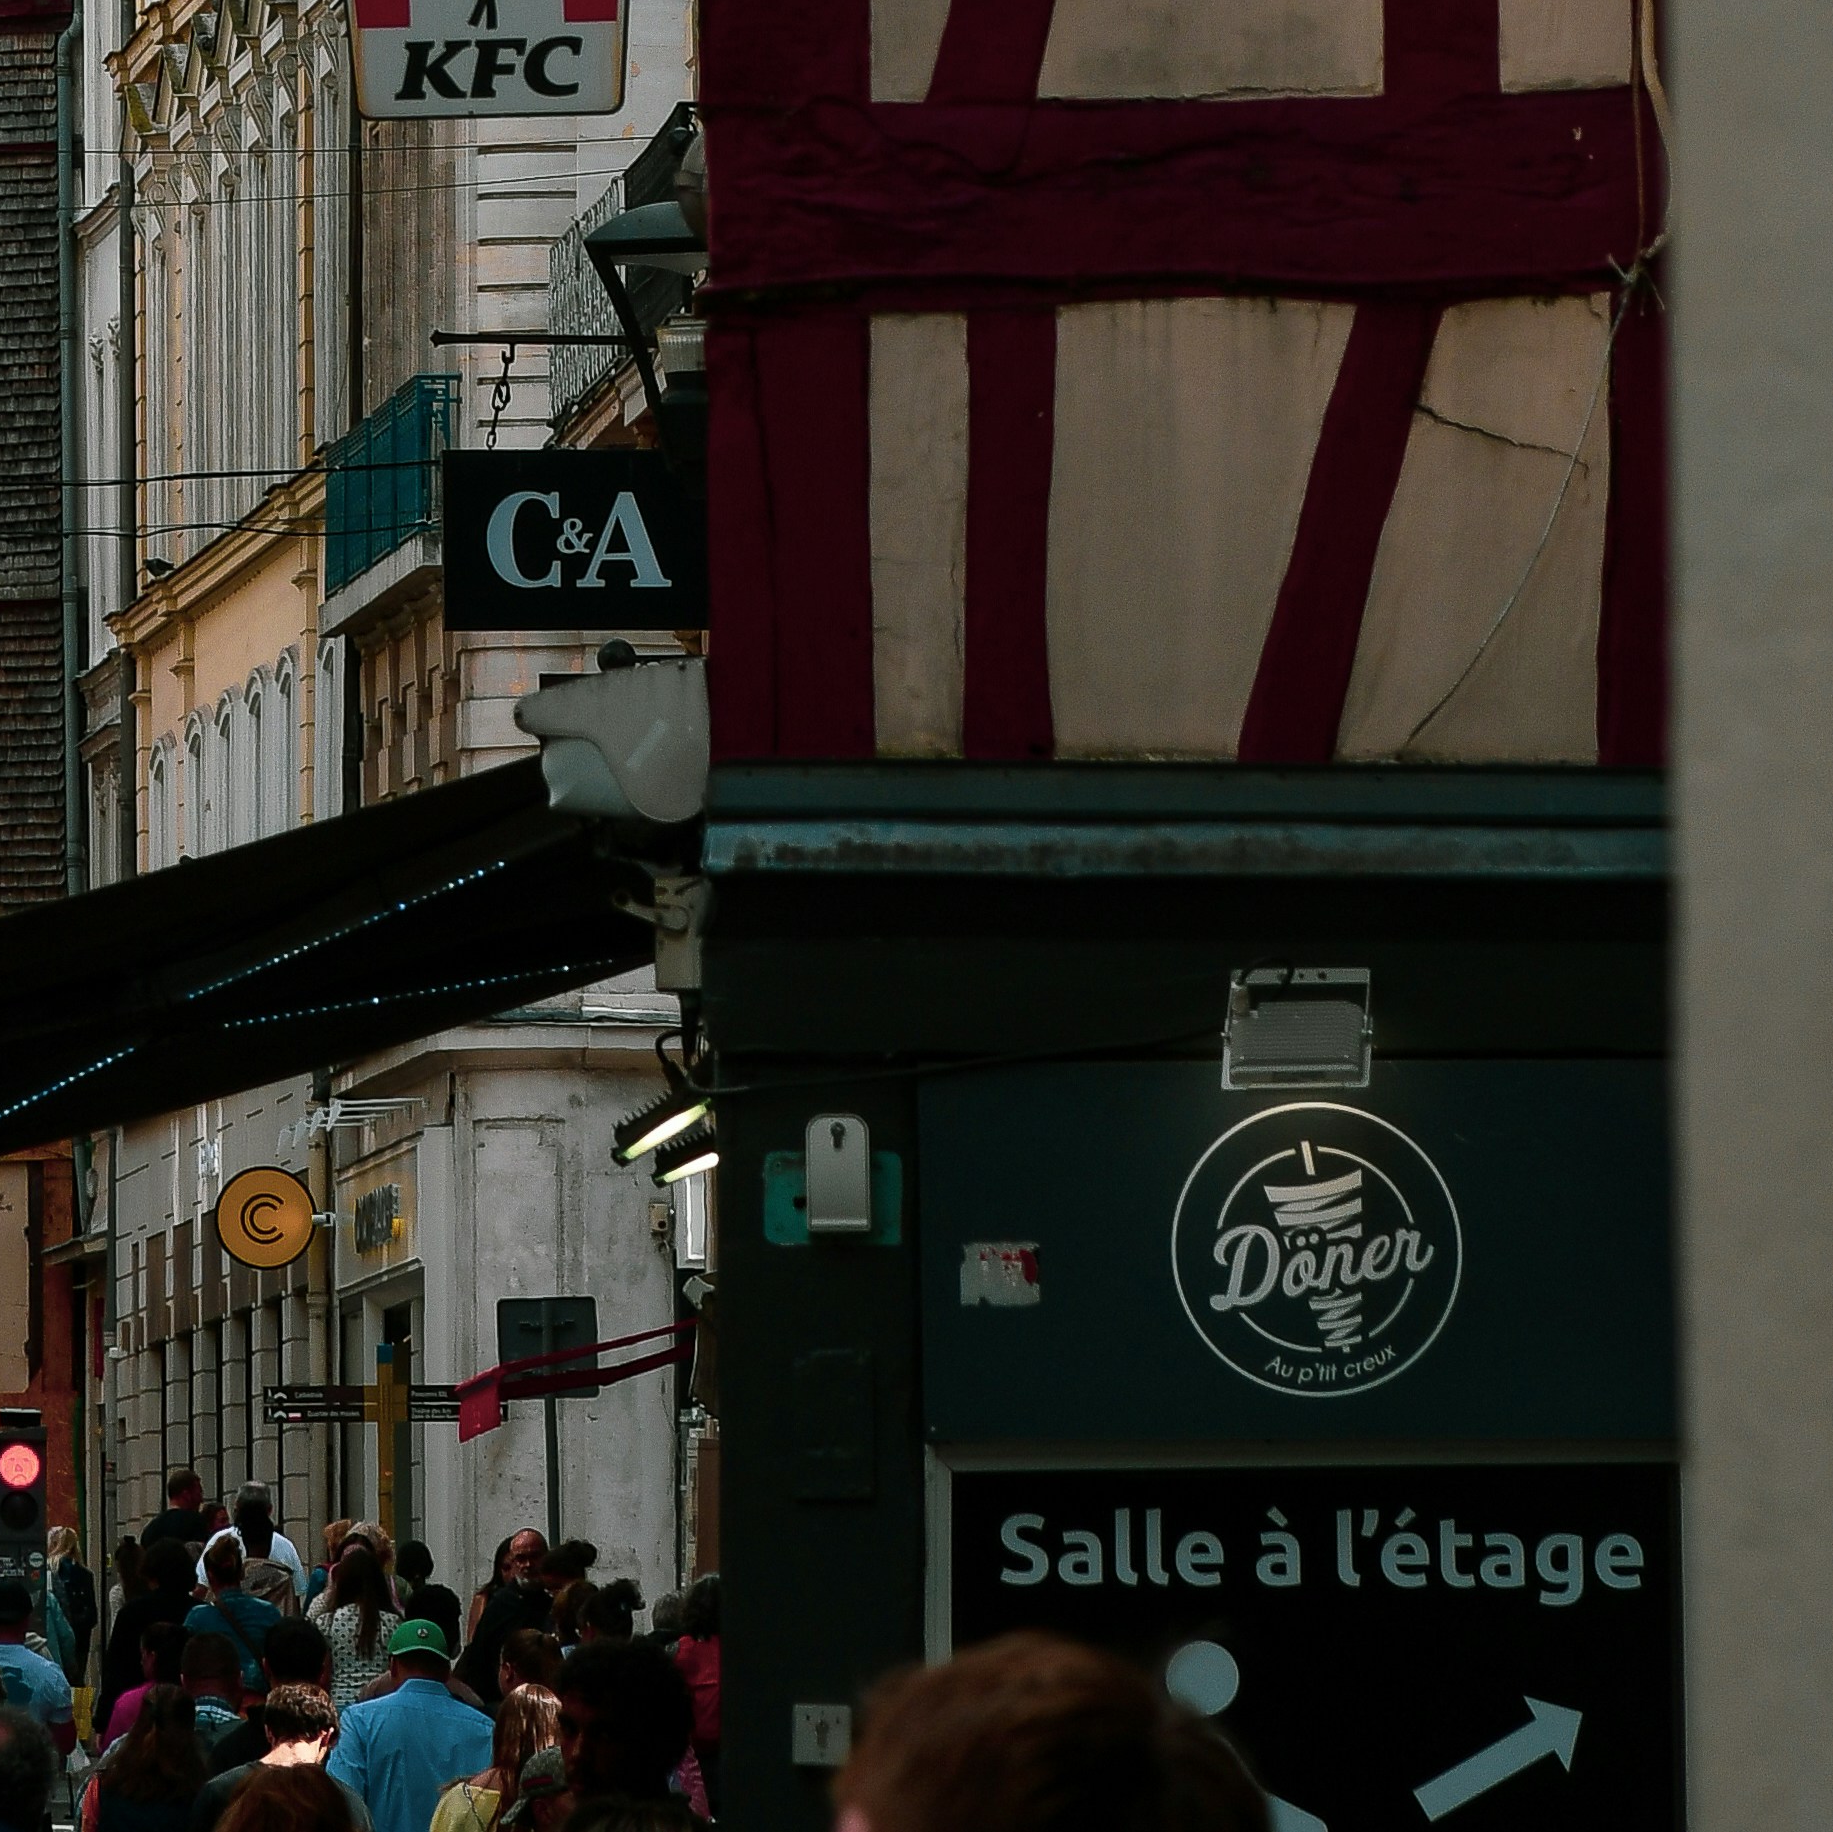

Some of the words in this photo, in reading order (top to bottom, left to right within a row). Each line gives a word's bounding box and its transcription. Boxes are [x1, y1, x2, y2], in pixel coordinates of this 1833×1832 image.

[394, 35, 583, 102] KFC
[487, 490, 672, 589] C&A
[1209, 1224, 1434, 1312] Döner
[1265, 1355, 1294, 1379] Au
[1297, 1362, 1338, 1385] p'tit
[1343, 1344, 1397, 1379] creux
[1000, 1508, 1224, 1588] Salle
[1257, 1506, 1301, 1586] à
[1336, 1508, 1644, 1607] l'étage
